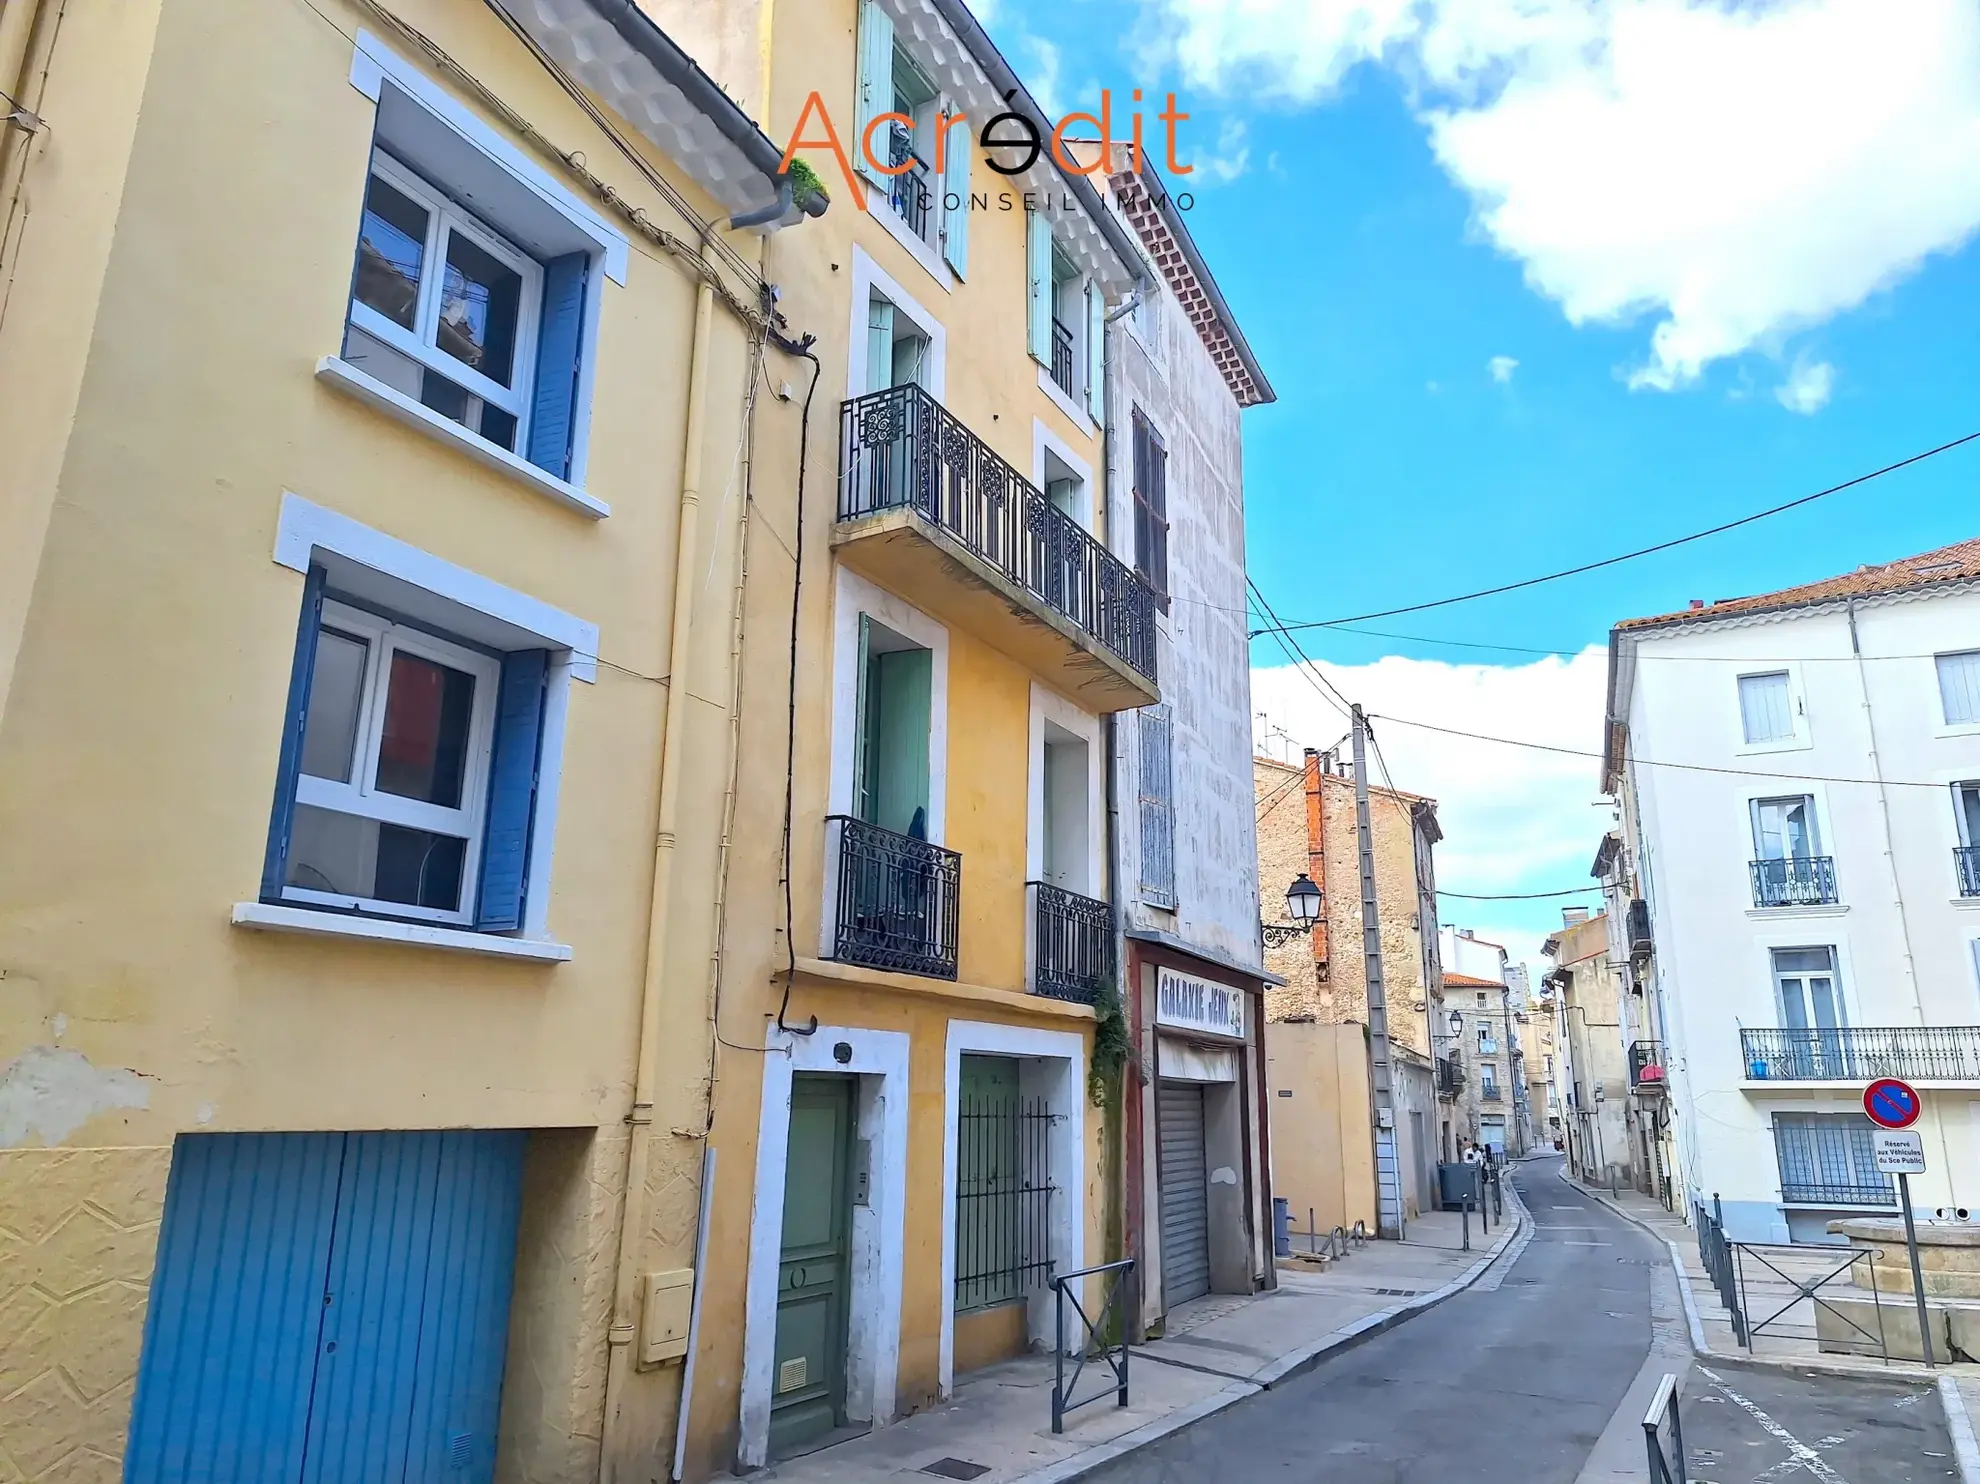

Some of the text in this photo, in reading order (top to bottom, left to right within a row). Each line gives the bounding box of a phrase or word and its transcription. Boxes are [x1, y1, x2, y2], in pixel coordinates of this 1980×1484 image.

[1161, 973, 1230, 1028] GALAXIE JEUX
[1884, 1140, 1911, 1148] Réservé
